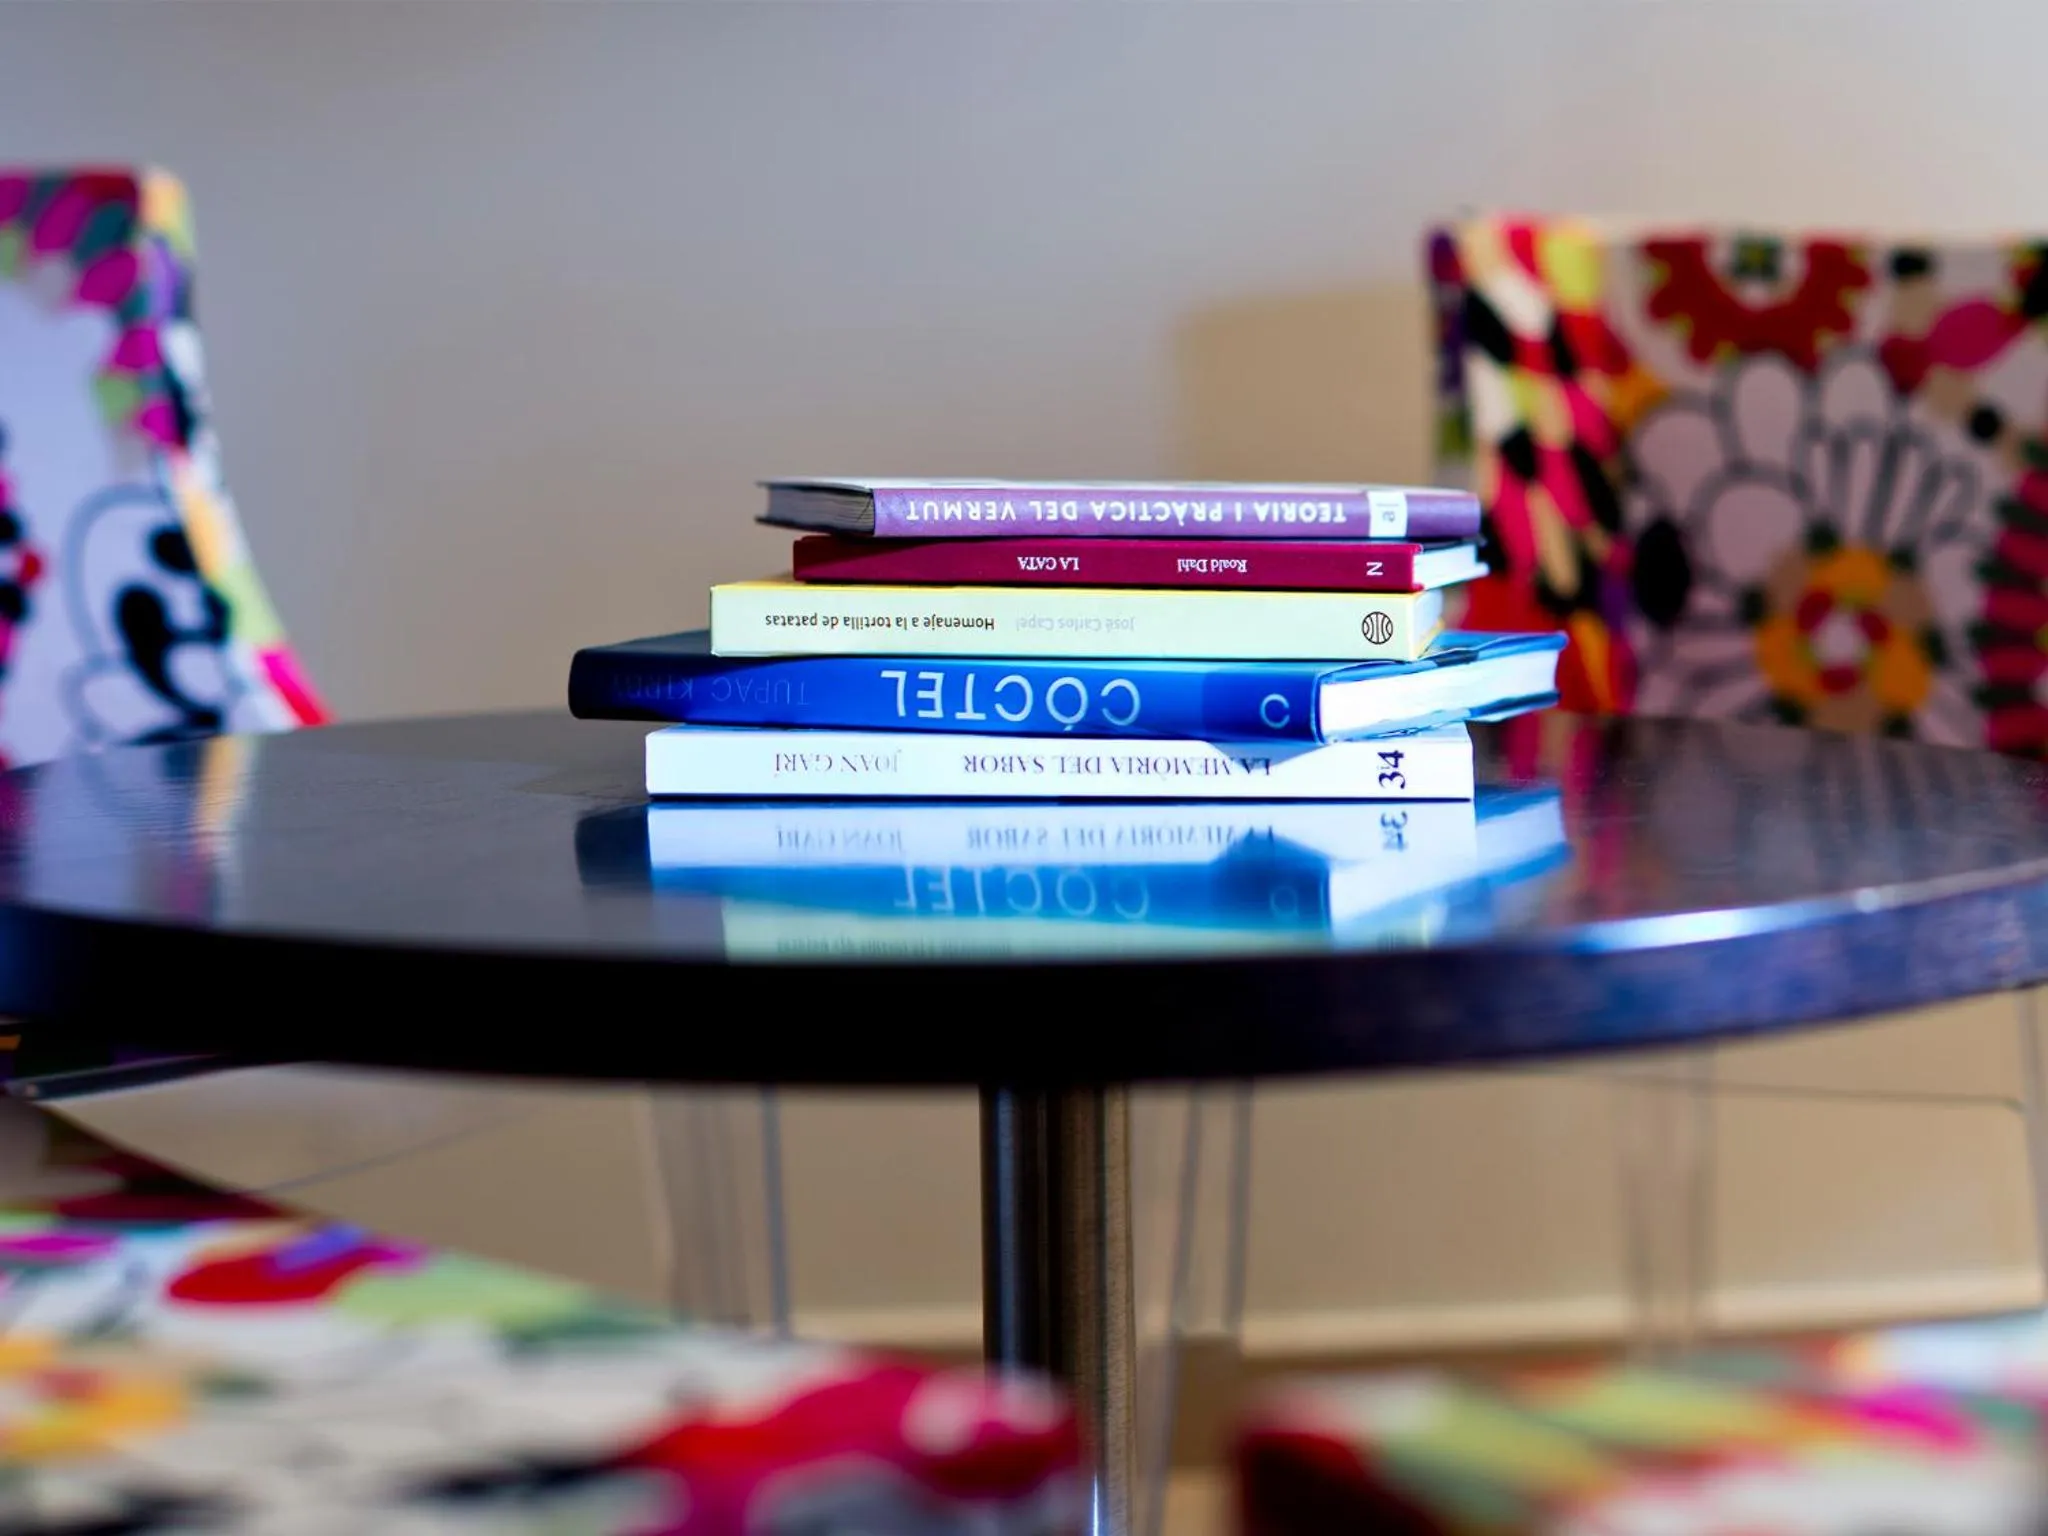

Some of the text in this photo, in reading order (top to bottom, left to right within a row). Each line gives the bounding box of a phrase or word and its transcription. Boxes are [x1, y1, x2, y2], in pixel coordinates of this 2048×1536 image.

[906, 500, 1347, 526] TEORIA I PRÀCTICA DEL VERMUT
[1017, 556, 1080, 571] LA CATA
[1177, 558, 1248, 573] Roald Dahl
[765, 613, 995, 631] Homenaje a la tortilla de patatas
[1016, 616, 1134, 632] José Carlos Capel
[709, 676, 811, 706] TUPAC
[880, 670, 1142, 732] CÓCTEL
[774, 750, 899, 777] JOAN GARÍ
[963, 754, 1045, 775] SABOR
[1052, 755, 1102, 775] DEL
[1243, 757, 1271, 776] LA
[1377, 749, 1407, 790] 34
